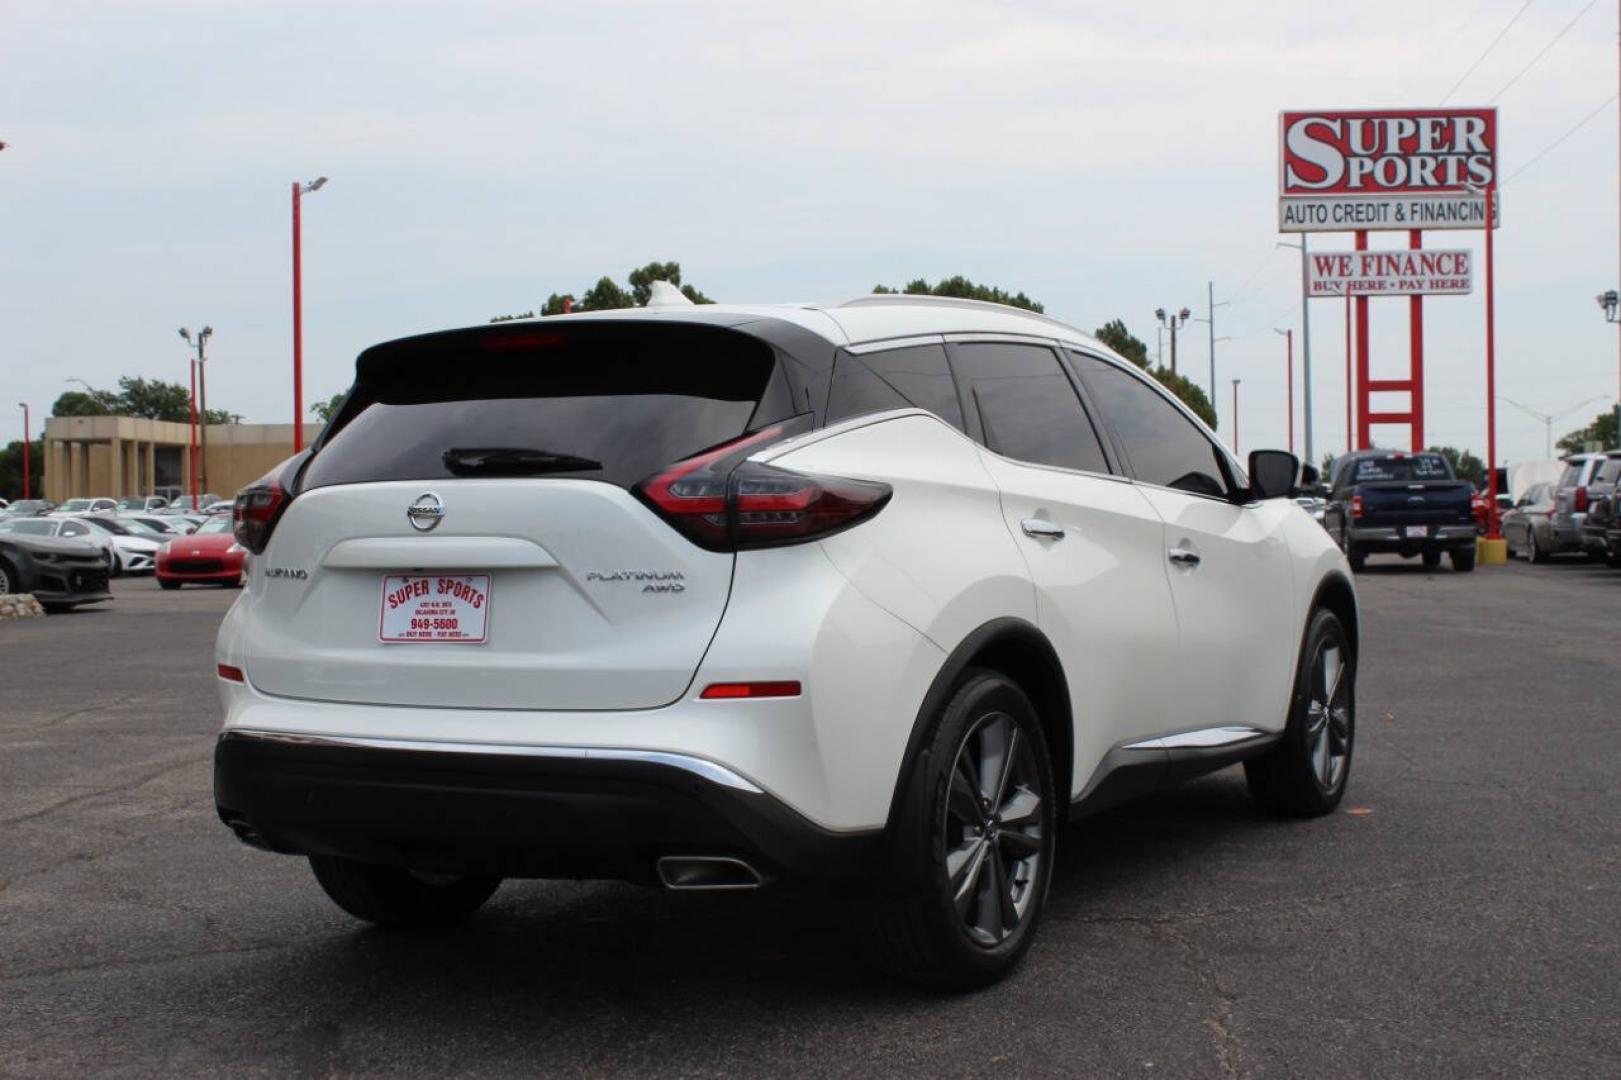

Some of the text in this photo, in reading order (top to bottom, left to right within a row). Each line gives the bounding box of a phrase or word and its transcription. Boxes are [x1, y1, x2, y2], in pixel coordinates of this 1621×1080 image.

[1287, 116, 1491, 189] SUPER
[1284, 204, 1328, 224] AUTO
[1332, 203, 1390, 222] CREDIT
[1394, 203, 1405, 221] &
[1313, 252, 1469, 277] WE FINANCE
[1313, 278, 1470, 291] BUY HERE PAY HERE
[585, 569, 685, 581] PLATINUM
[388, 578, 484, 609] SUPER SPORTS
[642, 583, 685, 593] AWD
[411, 618, 458, 630] 949-5600
